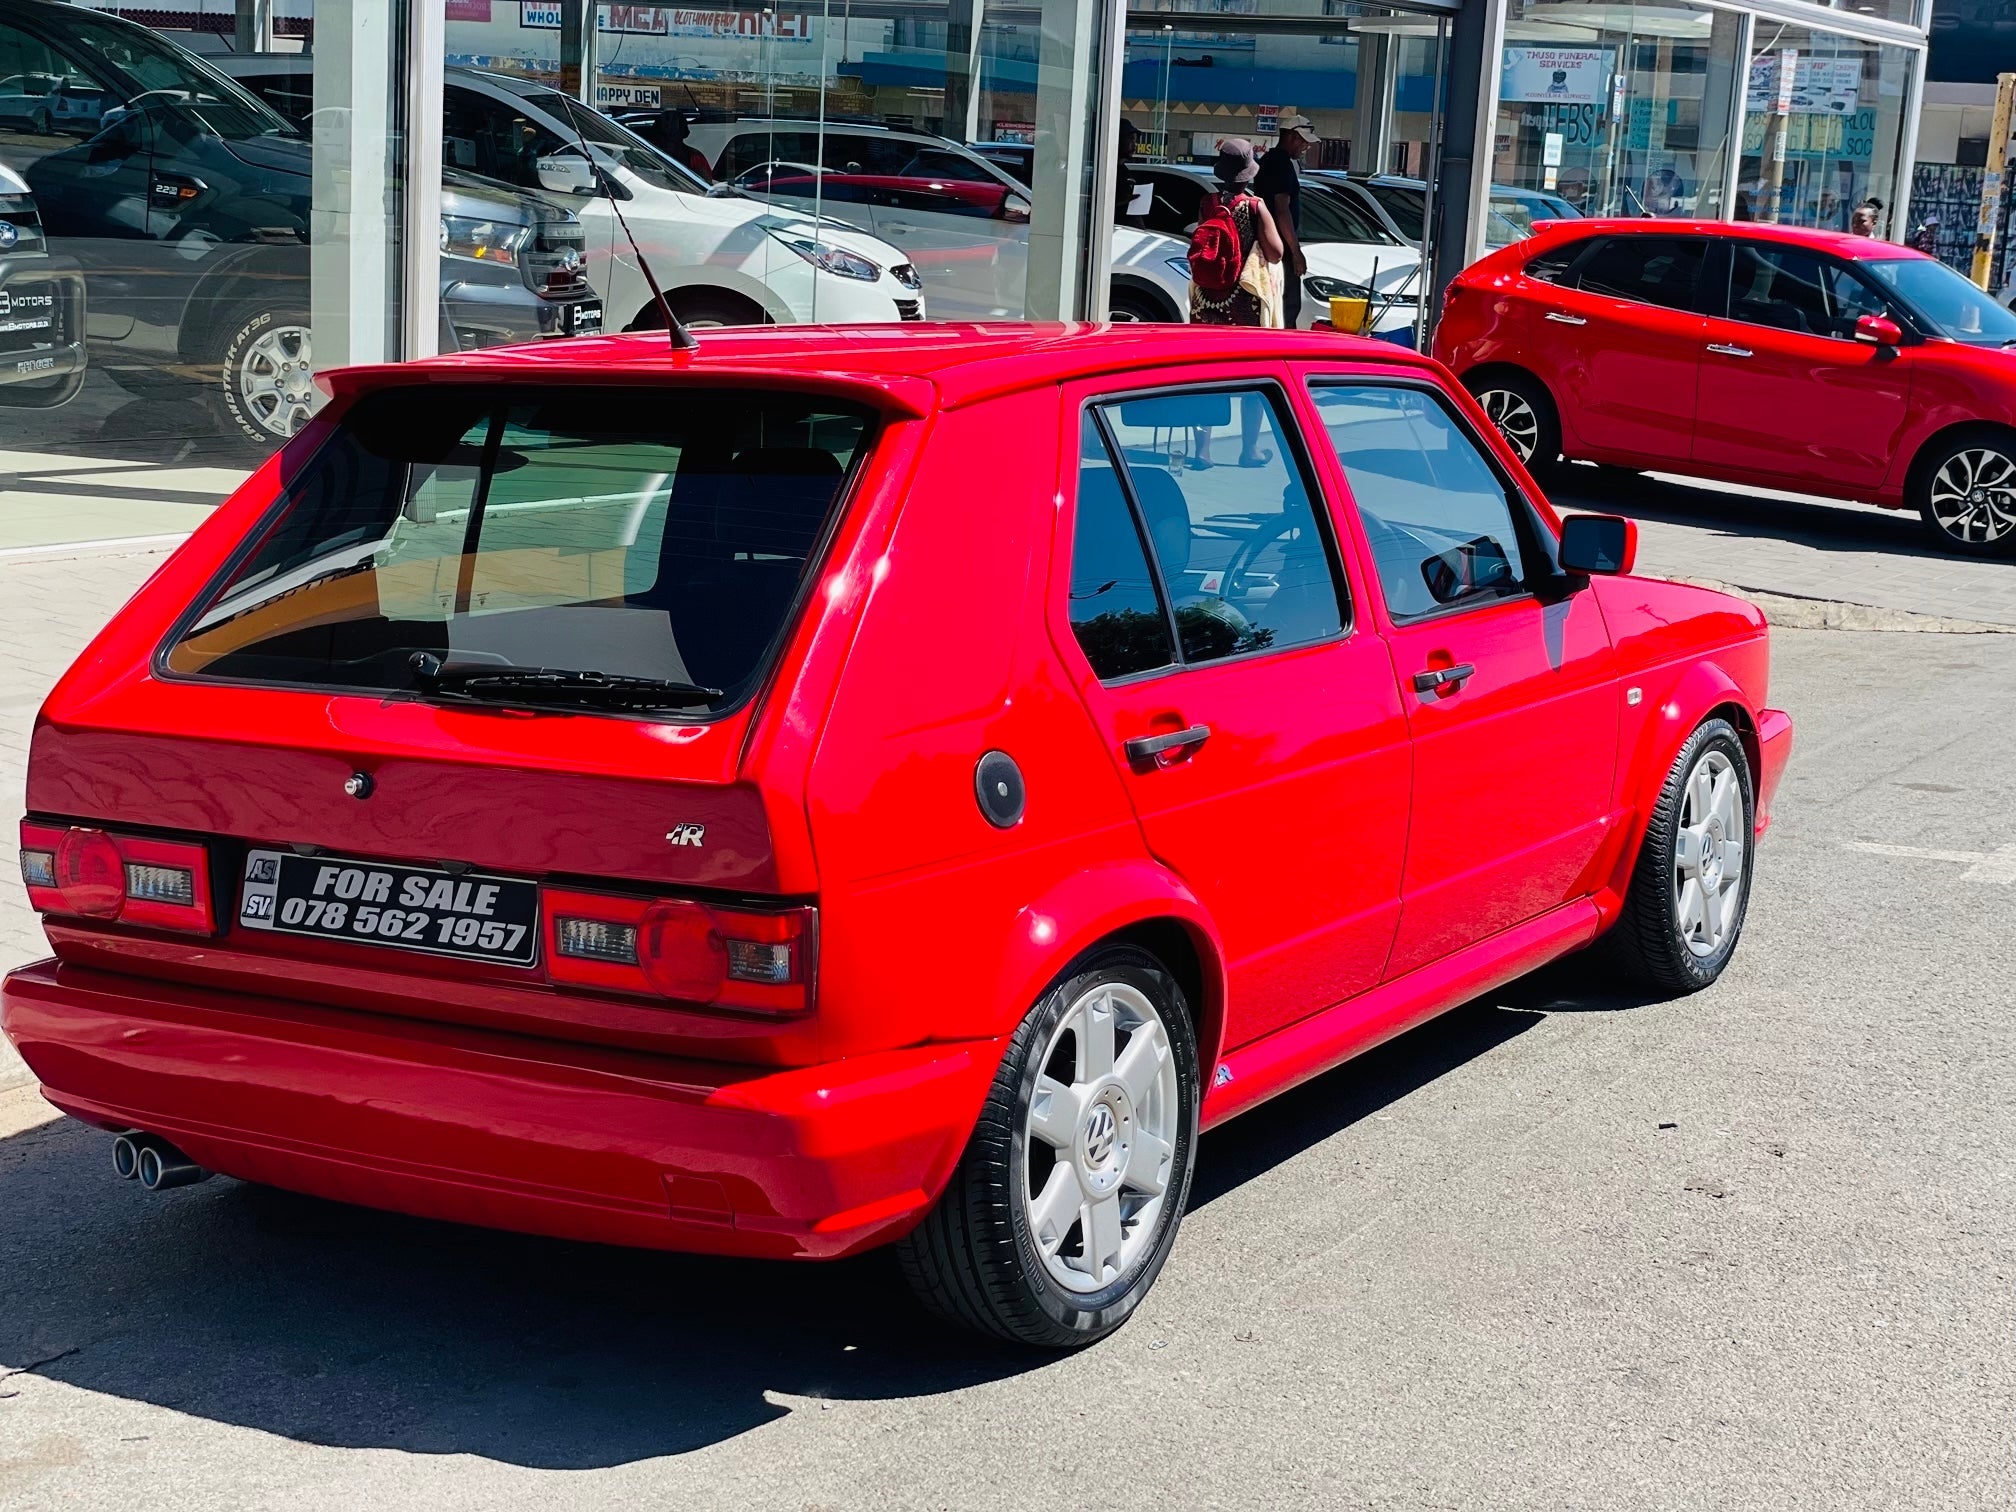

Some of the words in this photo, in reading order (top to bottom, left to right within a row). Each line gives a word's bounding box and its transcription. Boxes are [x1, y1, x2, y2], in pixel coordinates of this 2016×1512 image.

[674, 10, 714, 26] CLOTHING
[1526, 51, 1555, 60] THUSO
[1558, 52, 1600, 61] FUNERAL
[1539, 60, 1583, 69] SERVICES
[634, 89, 660, 105] DEN
[11, 295, 53, 308] MOTORS
[236, 312, 271, 346] AT3G
[222, 343, 267, 443] GRANDTREK
[312, 865, 396, 903] FOR
[399, 874, 501, 917] SALE
[245, 894, 272, 916] SV
[280, 896, 349, 930] 078
[353, 904, 426, 943] 562
[436, 914, 528, 953] 1957
